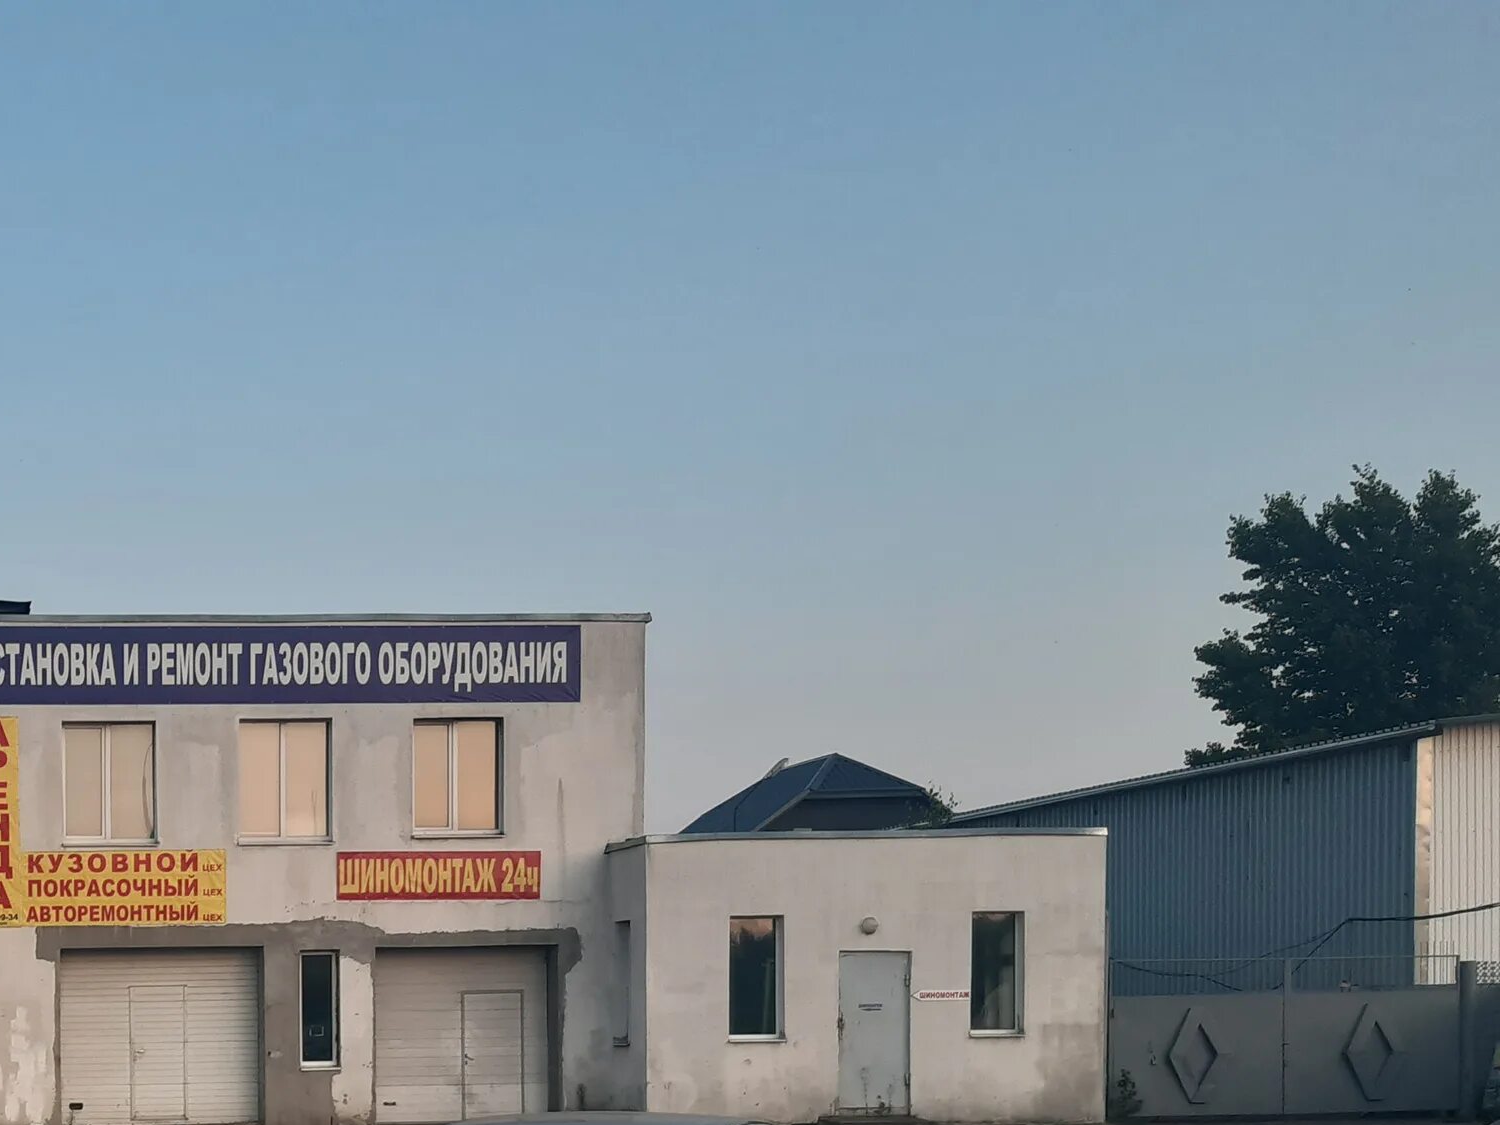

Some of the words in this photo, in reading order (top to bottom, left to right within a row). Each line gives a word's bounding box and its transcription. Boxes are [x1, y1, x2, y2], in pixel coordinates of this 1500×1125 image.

[123, 643, 140, 686] И
[147, 642, 243, 686] РЕМОНТ
[250, 642, 371, 686] ГАЗОВОГО
[378, 641, 567, 693] ОБОРУДОВАНИЯ
[27, 849, 198, 874] КУЗОВНОЙ
[202, 863, 223, 873] ЦЕХ
[27, 874, 199, 898] ПОКРАСОЧНЫЙ
[203, 887, 223, 897] ЦЕХ
[339, 858, 497, 894] ШИНОМОНТАЖ
[501, 857, 539, 893] 24ч
[26, 901, 199, 923] АВТОРЕМОНТНЫЙ
[203, 912, 223, 923] ЦЕХ
[919, 991, 970, 999] ШИНОМОНТАЖ
